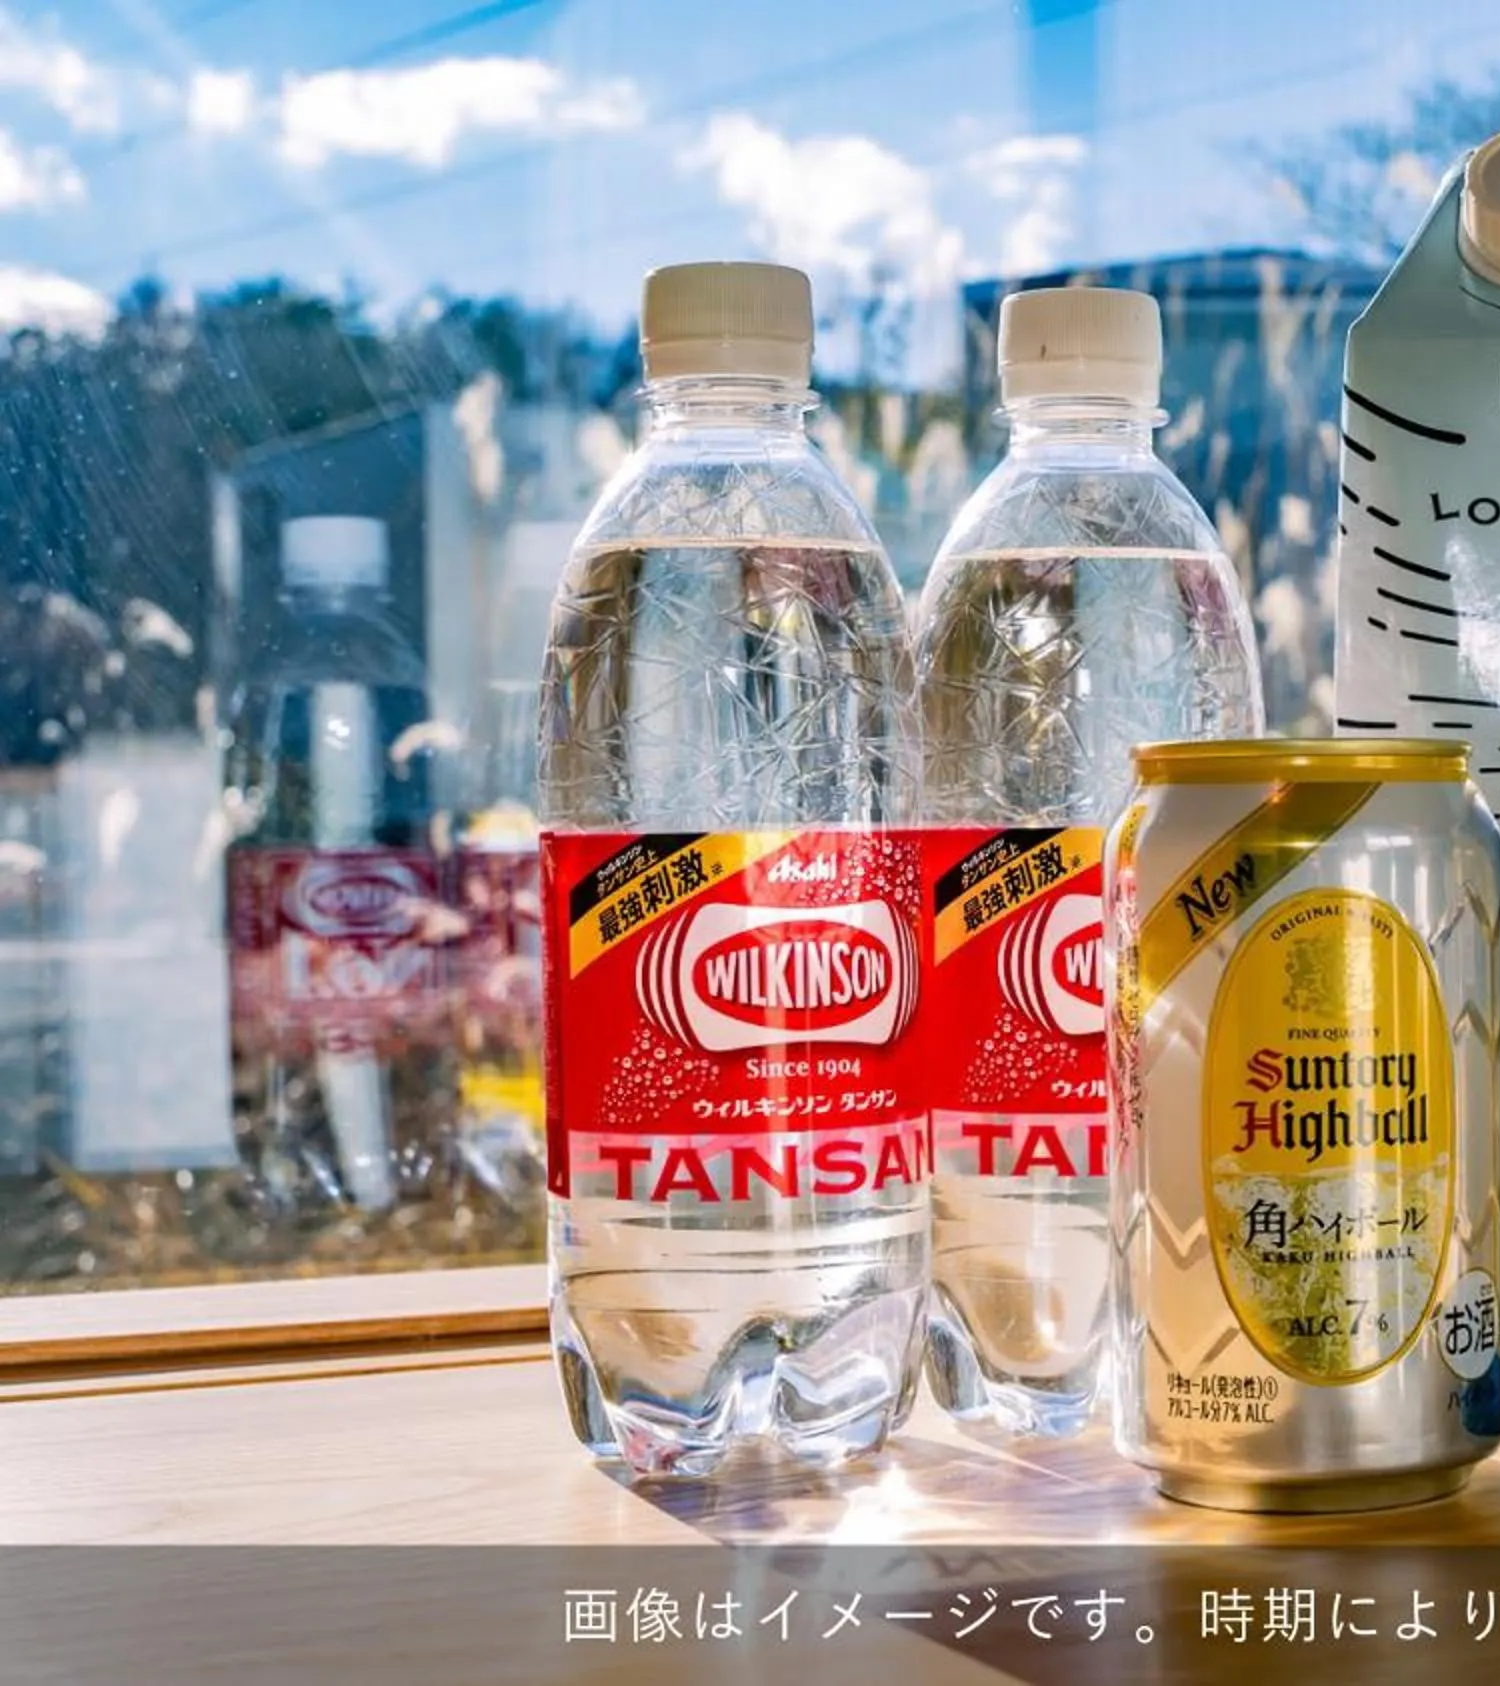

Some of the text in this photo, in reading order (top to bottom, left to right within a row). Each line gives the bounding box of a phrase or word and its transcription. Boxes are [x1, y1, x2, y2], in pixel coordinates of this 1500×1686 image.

[767, 851, 838, 883] Asahi
[1176, 852, 1257, 940] New
[705, 940, 886, 1010] WILKINSON
[1288, 1027, 1381, 1042] FINE QUATY
[746, 1058, 862, 1080] Since 1904
[1246, 1047, 1417, 1096] Suntory
[693, 1089, 897, 1119] ウィルキンソン タンサン
[1232, 1094, 1428, 1163] Highball
[1243, 1199, 1429, 1249] 角ハイボール
[1262, 1251, 1313, 1264] KAKU
[1289, 1315, 1344, 1337] ALC.
[1445, 1297, 1495, 1355] お酒
